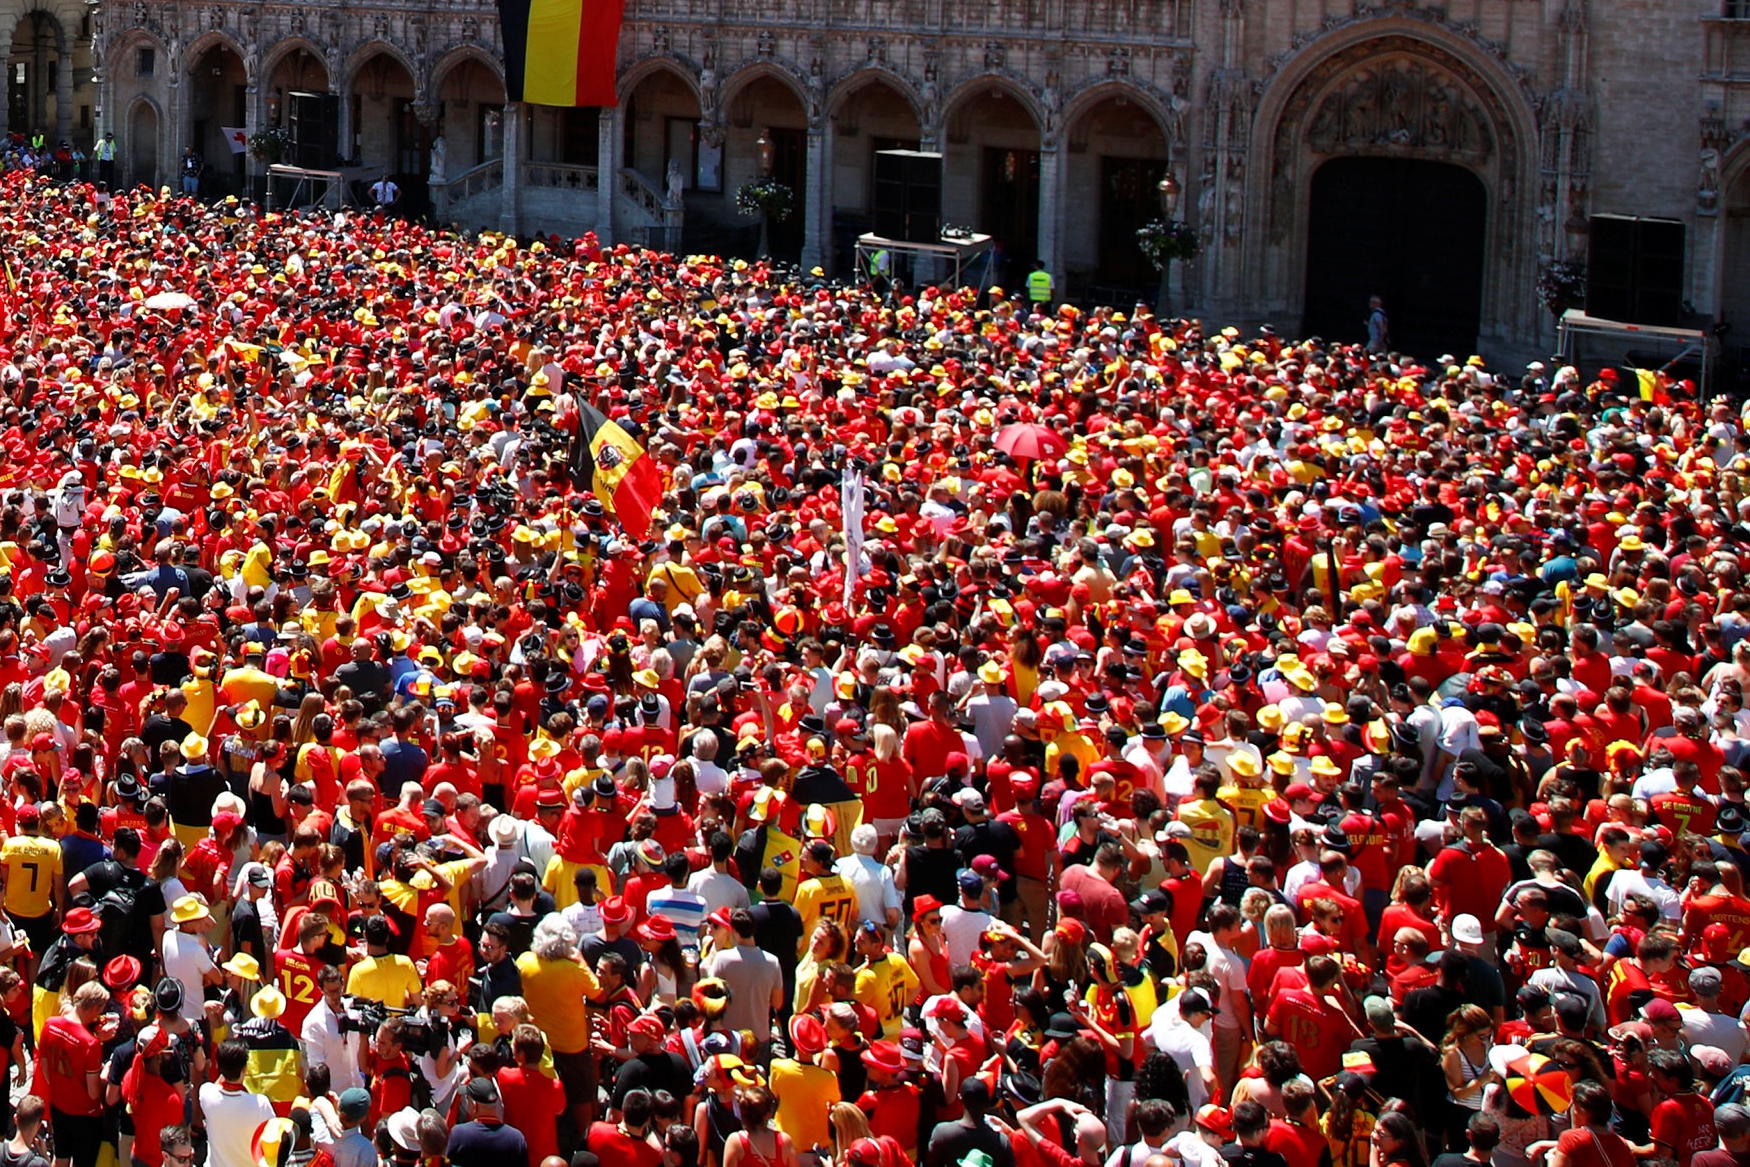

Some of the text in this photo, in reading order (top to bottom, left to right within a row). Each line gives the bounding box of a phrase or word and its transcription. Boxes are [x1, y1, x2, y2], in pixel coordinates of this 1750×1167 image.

[1674, 814, 1690, 841] 7
[22, 862, 39, 893] 7
[285, 957, 310, 975] BELGIUM
[281, 969, 314, 1004] 12
[1290, 1015, 1318, 1048] 18
